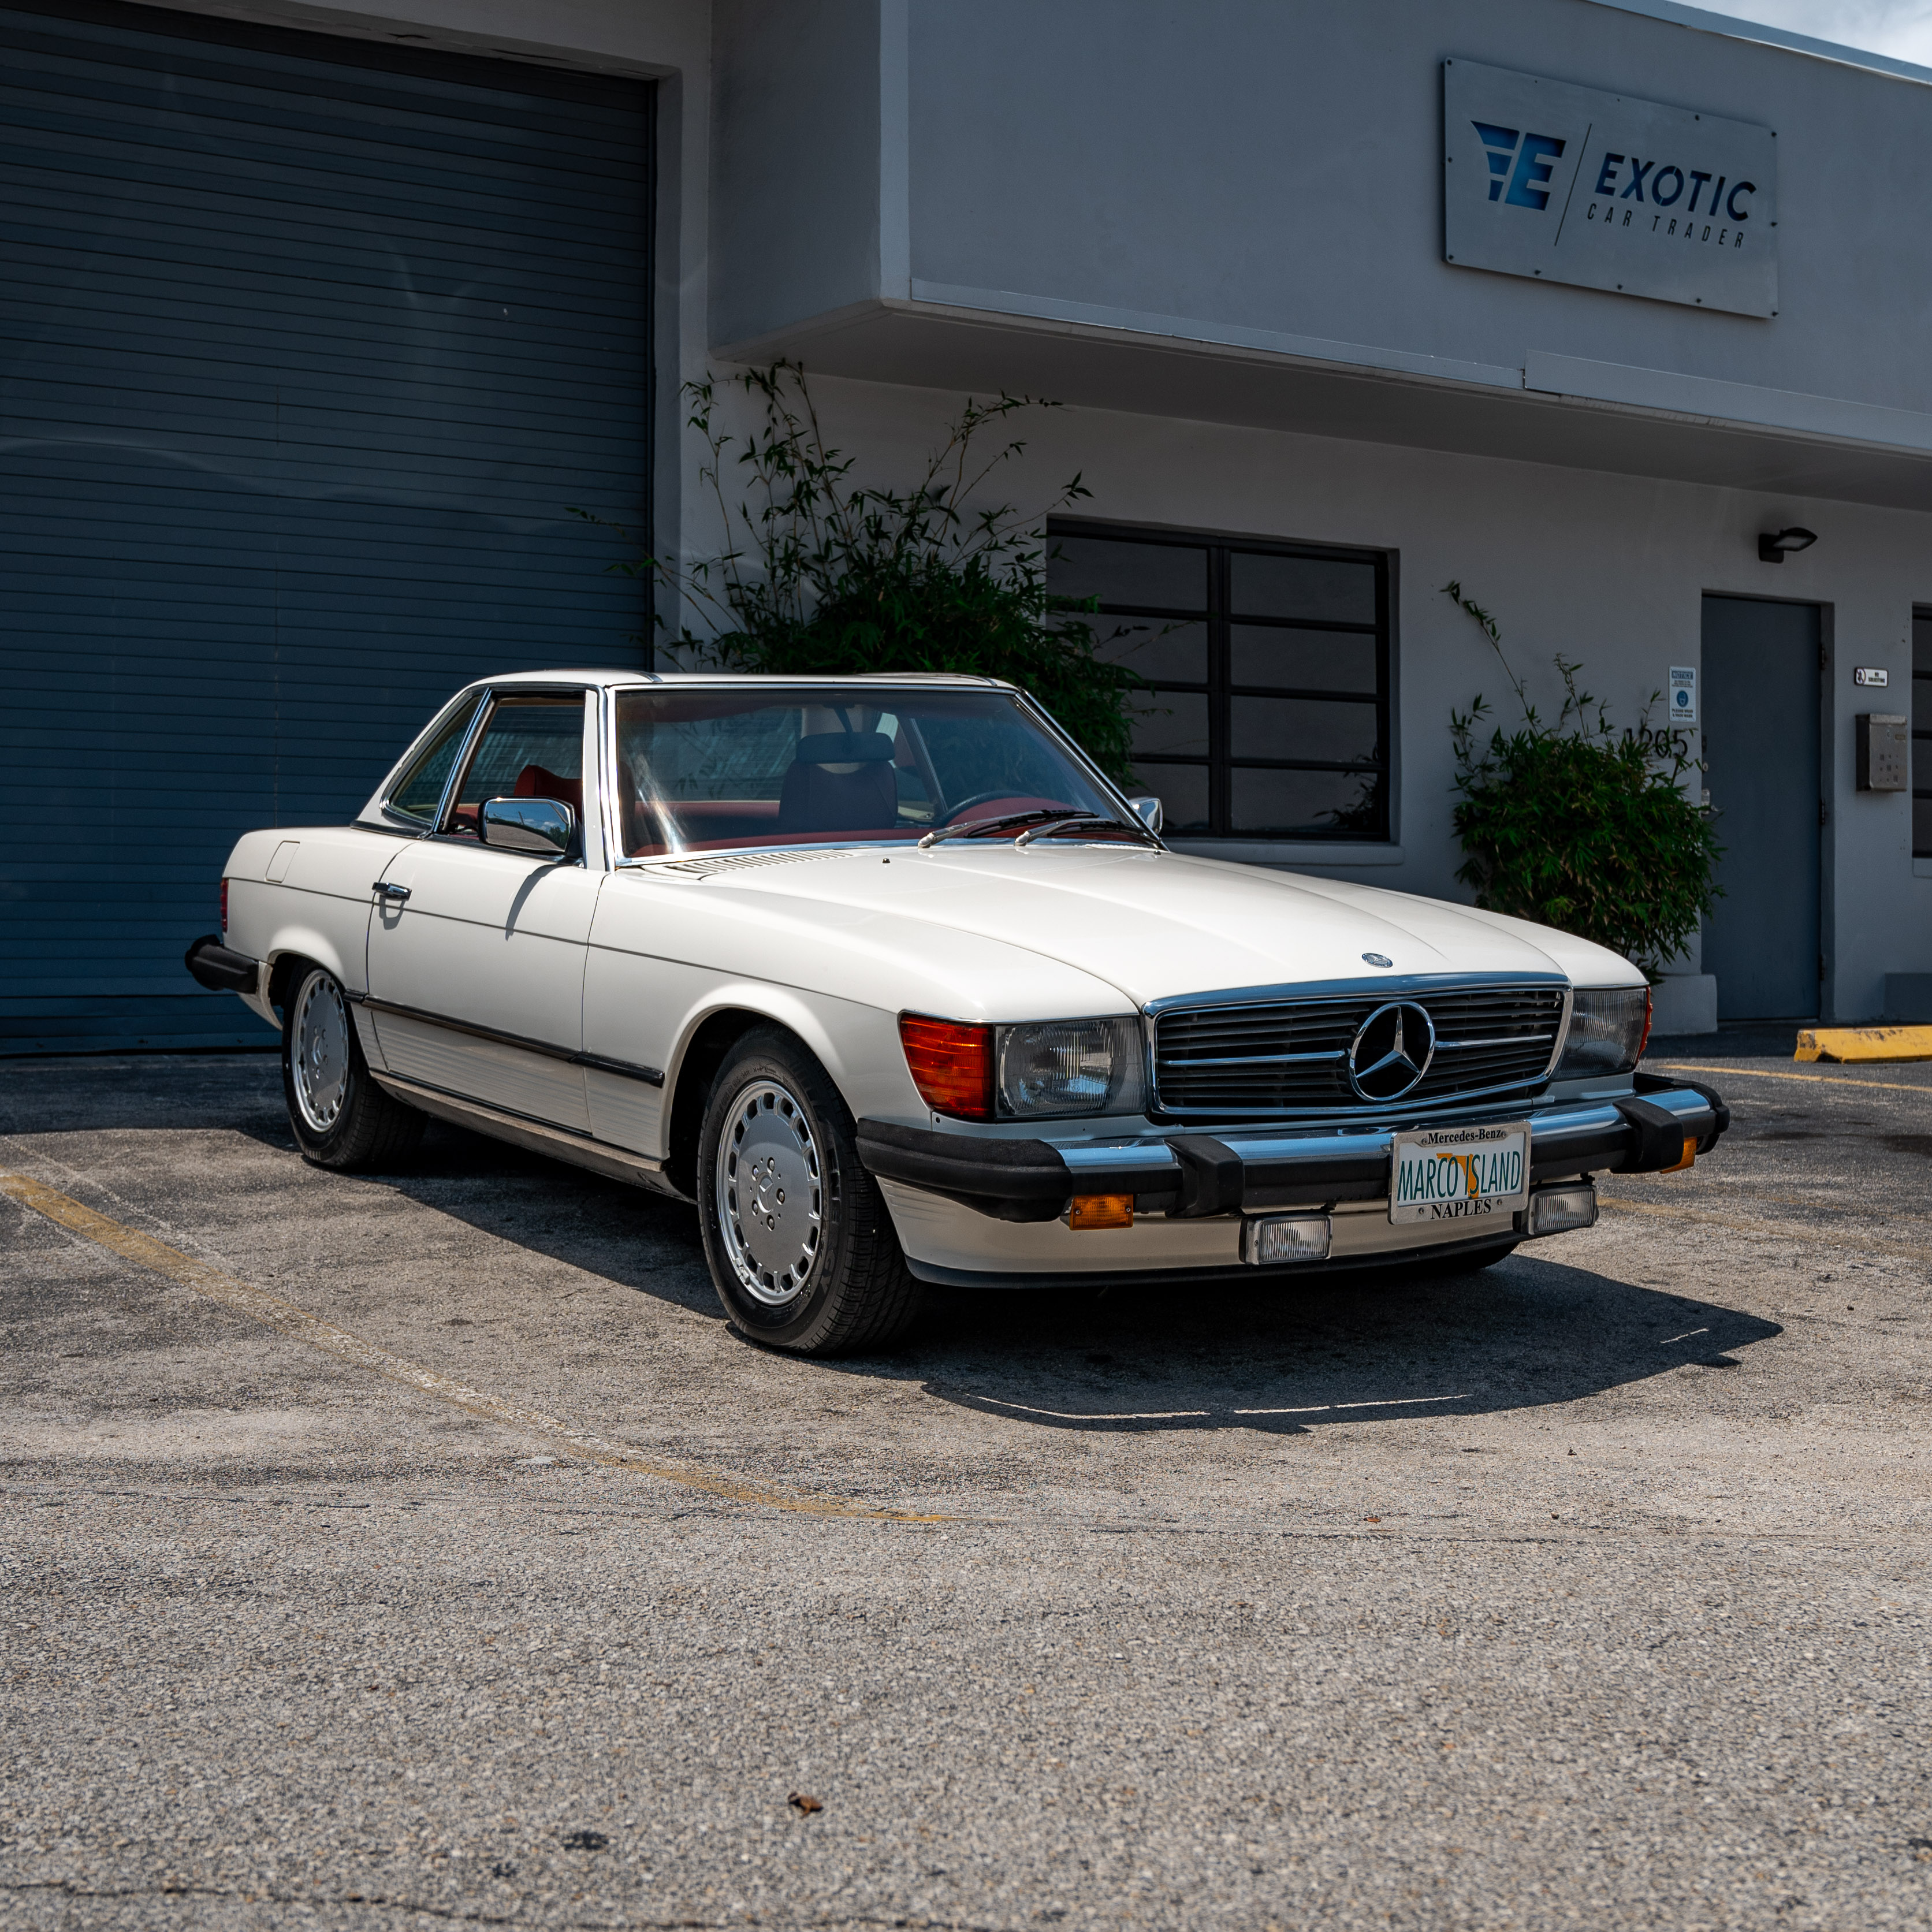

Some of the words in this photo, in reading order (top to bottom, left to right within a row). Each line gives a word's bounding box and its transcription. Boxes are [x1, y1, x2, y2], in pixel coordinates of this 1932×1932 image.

[1595, 152, 1757, 222] EXOTIC
[1587, 203, 1632, 227] CAR
[1652, 215, 1744, 248] TRADER
[1427, 1129, 1502, 1145] Mercedes-Benz
[1397, 1156, 1458, 1201] MARCO
[1464, 1151, 1521, 1196] ISLAND
[1430, 1198, 1492, 1220] NAPLES
